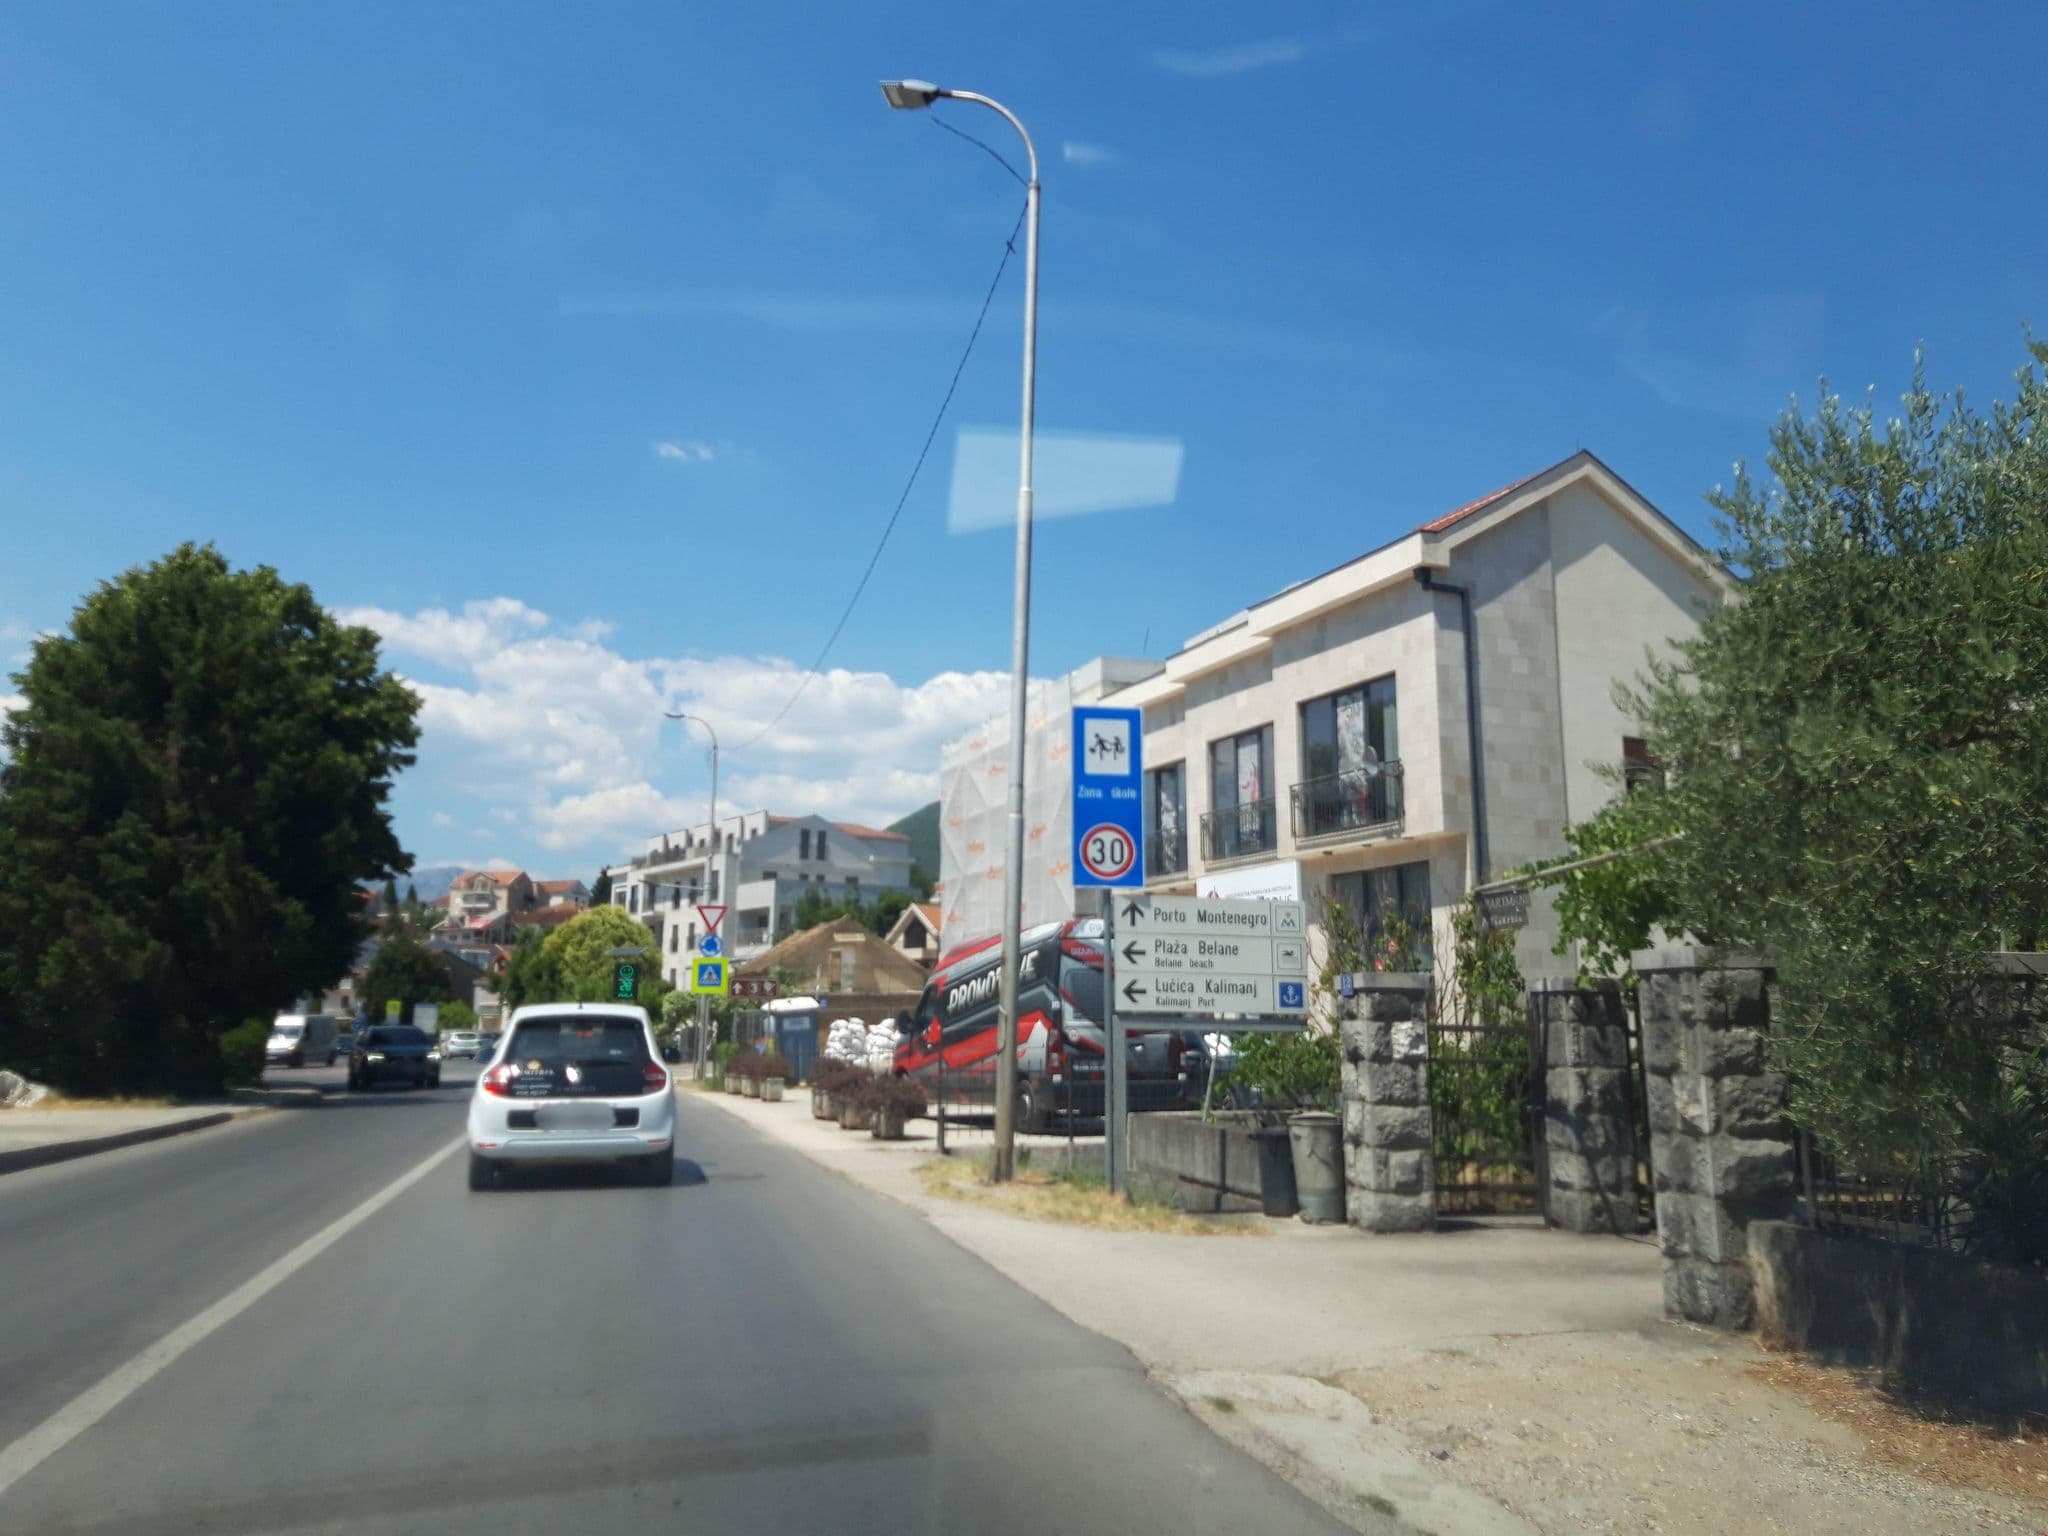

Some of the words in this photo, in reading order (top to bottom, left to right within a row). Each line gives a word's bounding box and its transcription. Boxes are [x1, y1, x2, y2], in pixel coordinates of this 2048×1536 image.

[1077, 784, 1103, 799] Zona
[1091, 837, 1125, 865] 30
[1154, 907, 1186, 923] Porto
[1197, 909, 1267, 928] Montenegro
[1154, 939, 1188, 954] Plaža
[1198, 941, 1239, 955] Belane
[1154, 959, 1183, 968] Belane
[1189, 959, 1214, 969] beach
[1205, 979, 1258, 998] Kalimanj
[1155, 996, 1191, 1009] Kalimanj
[1197, 997, 1215, 1007] Port
